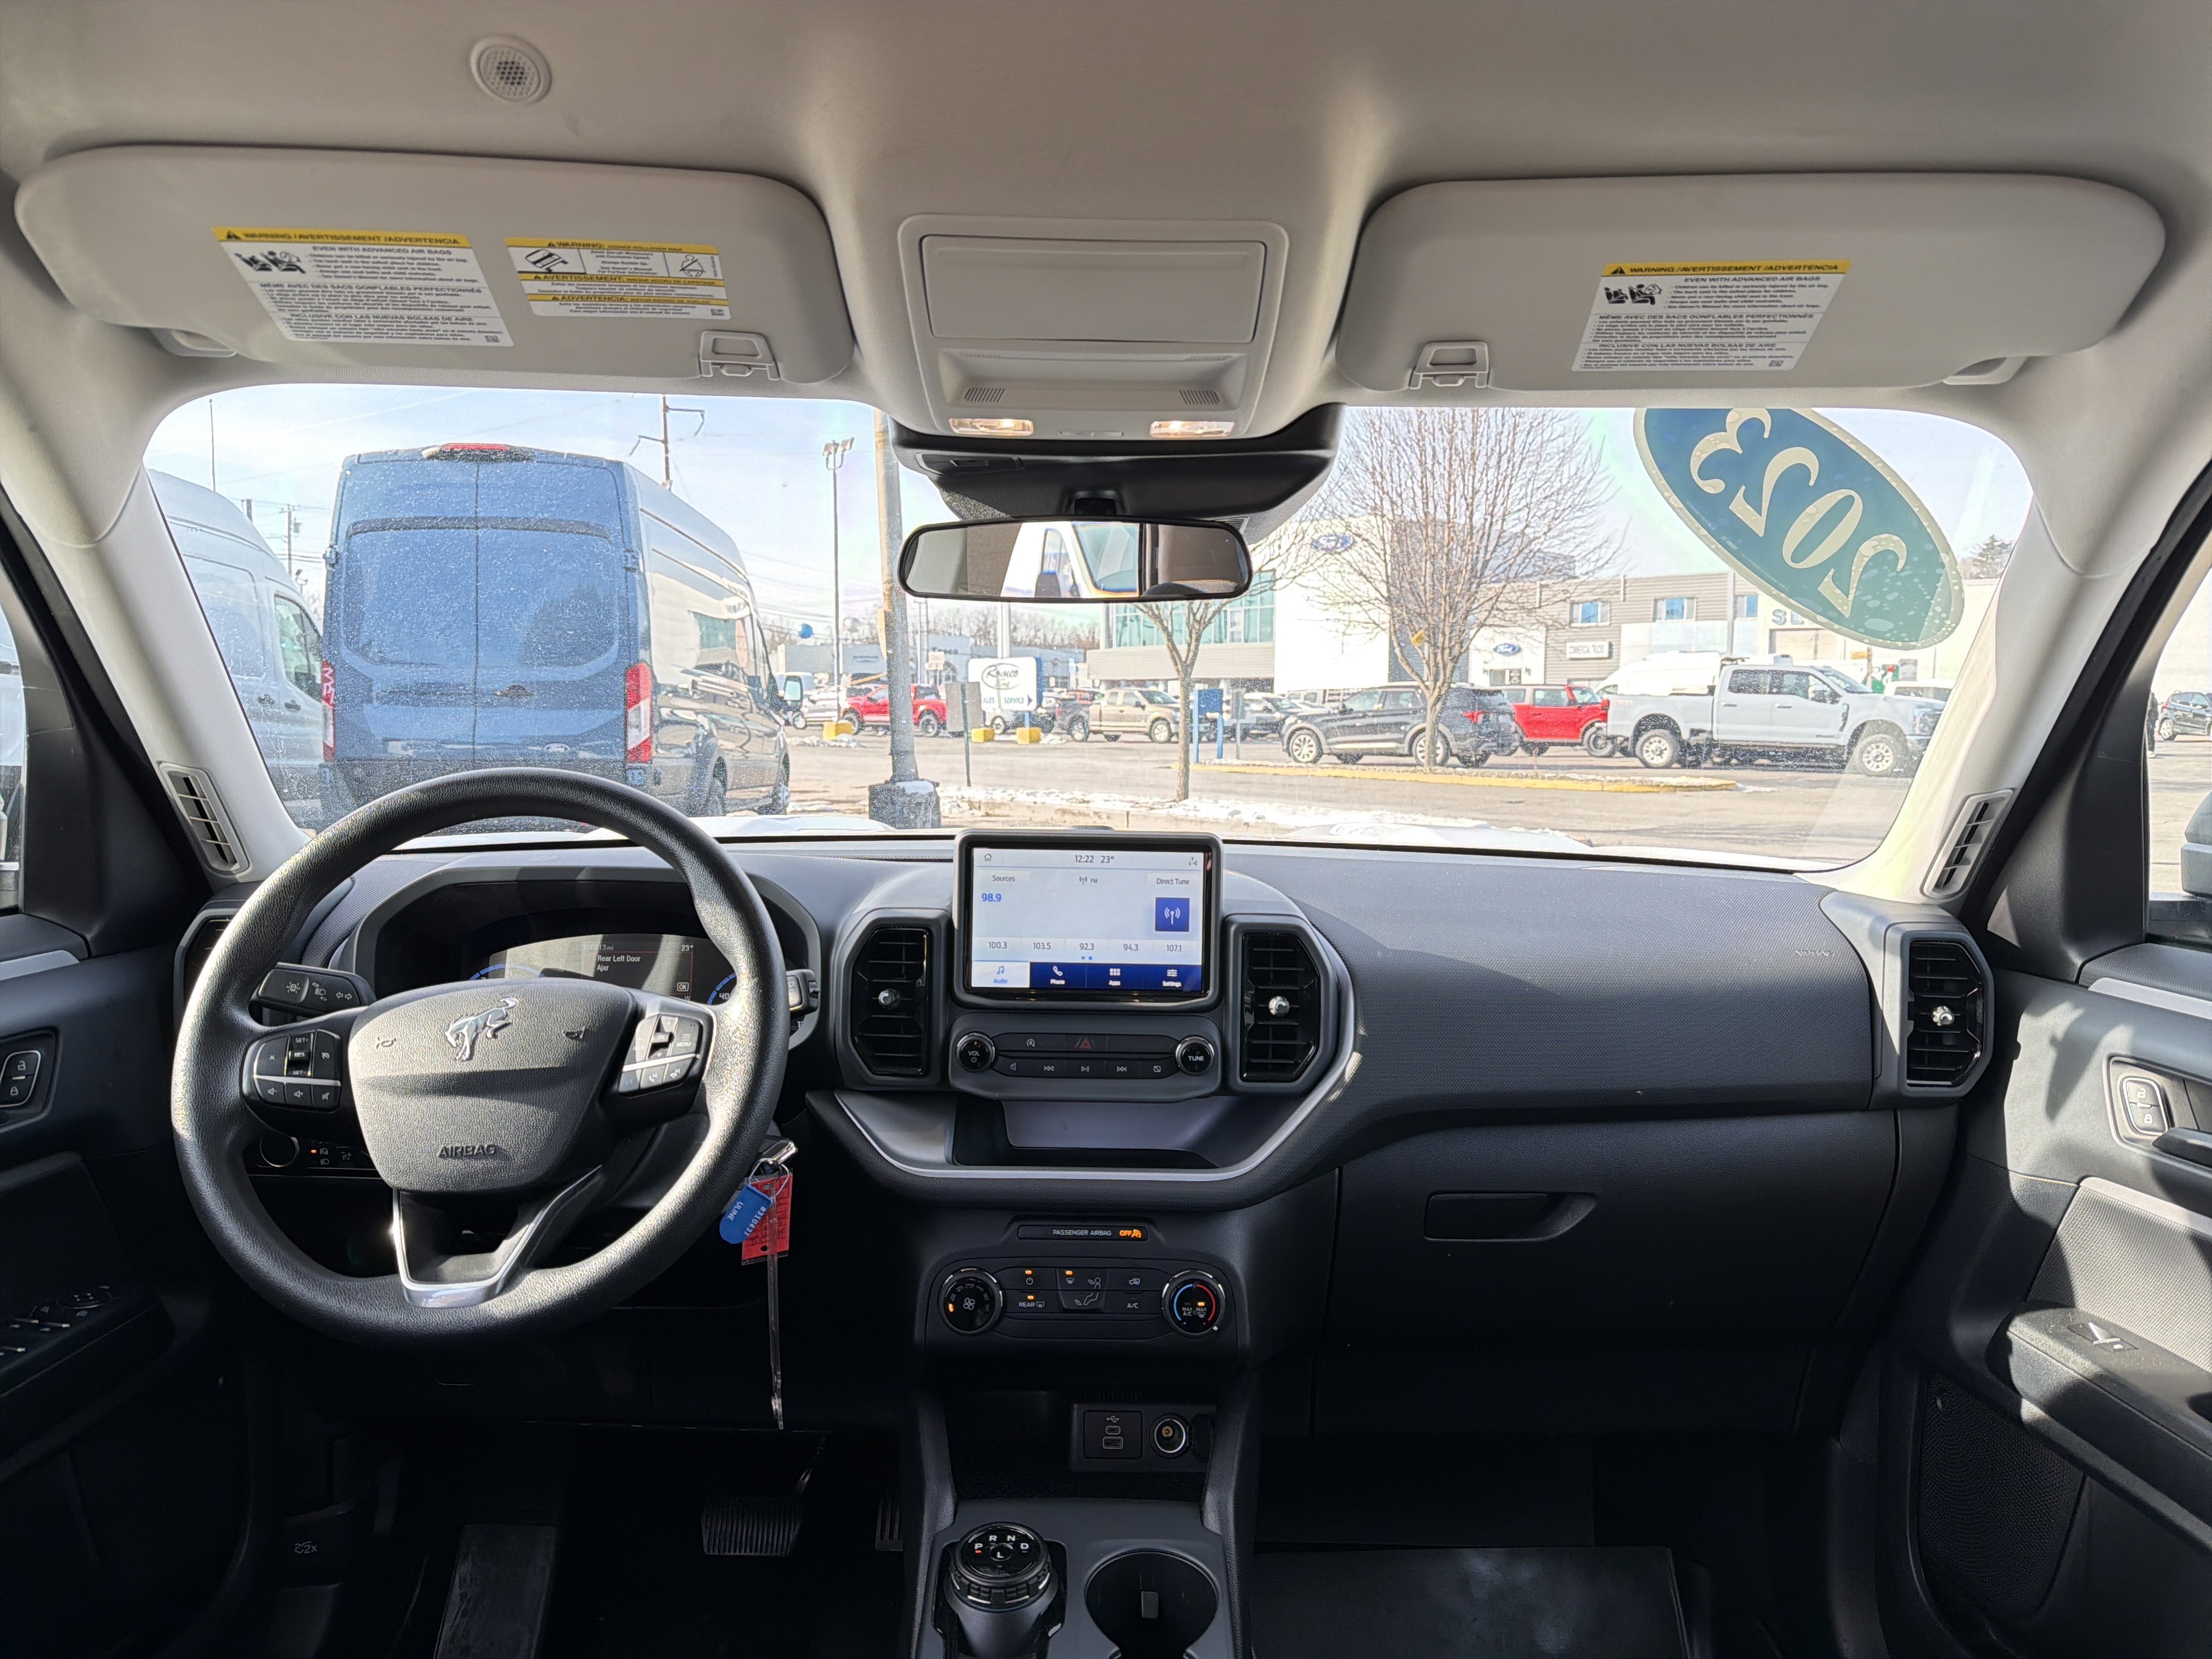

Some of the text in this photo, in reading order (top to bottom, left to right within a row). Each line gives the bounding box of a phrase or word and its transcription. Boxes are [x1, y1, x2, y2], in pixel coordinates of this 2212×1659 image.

[1074, 855, 1114, 864] 12:22 23°
[981, 893, 1002, 902] 98.9
[989, 941, 1007, 950] 100.3
[1032, 942, 1051, 950] 103.5
[1123, 943, 1138, 951] 94.3
[1166, 944, 1182, 952] 107.1
[436, 1143, 497, 1158] AIRBAG
[727, 1201, 743, 1221] ULINE
